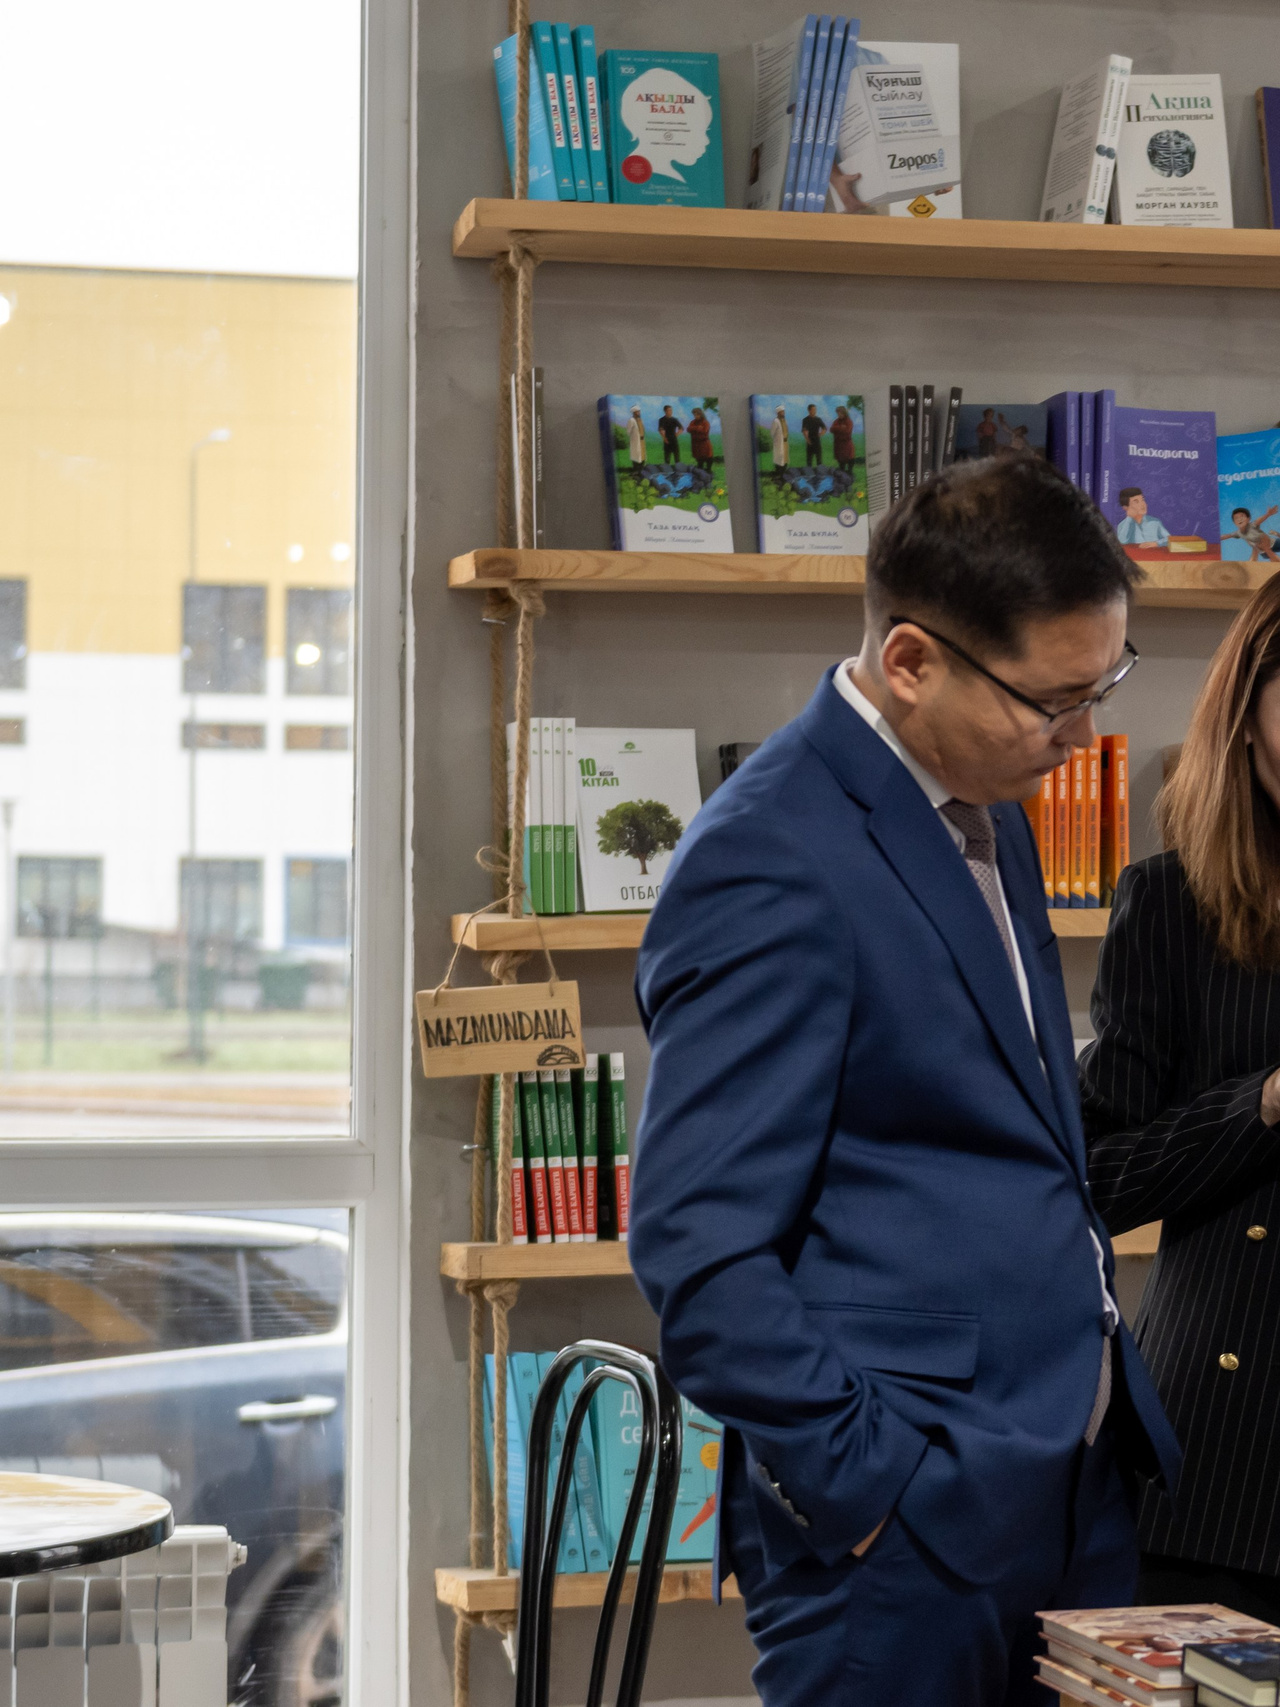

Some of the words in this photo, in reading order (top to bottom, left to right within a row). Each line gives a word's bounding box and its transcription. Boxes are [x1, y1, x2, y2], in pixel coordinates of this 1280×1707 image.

[866, 76, 922, 91] Қуаныш
[636, 93, 695, 104] АҚЫЛДЫ
[872, 90, 923, 102] сыйлау
[1146, 92, 1212, 111] Ақша
[650, 104, 685, 114] БАЛА
[1126, 104, 1214, 122] Психологиясы
[887, 152, 938, 170] Zappos
[1136, 202, 1176, 210] МОРГАН
[1128, 444, 1199, 460] Психология
[578, 758, 597, 777] 10
[582, 777, 620, 788] КІТАП
[620, 885, 661, 900] ОТБАС
[423, 1008, 576, 1048] MAZMUNDAMA
[513, 1172, 522, 1209] КАРНЕГИ
[535, 1172, 546, 1208] КАРНЕГИ
[554, 1170, 564, 1207] КАРНЕГИ
[568, 1170, 578, 1207] КАРНЕГИ
[586, 1170, 594, 1206] КАРНЕГИ
[618, 1170, 627, 1206] КАРНЕГИ
[514, 1210, 524, 1232] ДЕЙЛ
[537, 1210, 548, 1232] ДЕЙЛ
[556, 1208, 566, 1230] ДЕЙЛ
[570, 1208, 580, 1230] ДЕЙЛ
[586, 1208, 595, 1230] ДЕЙЛ
[620, 1207, 629, 1228] ДЕЙЛ
